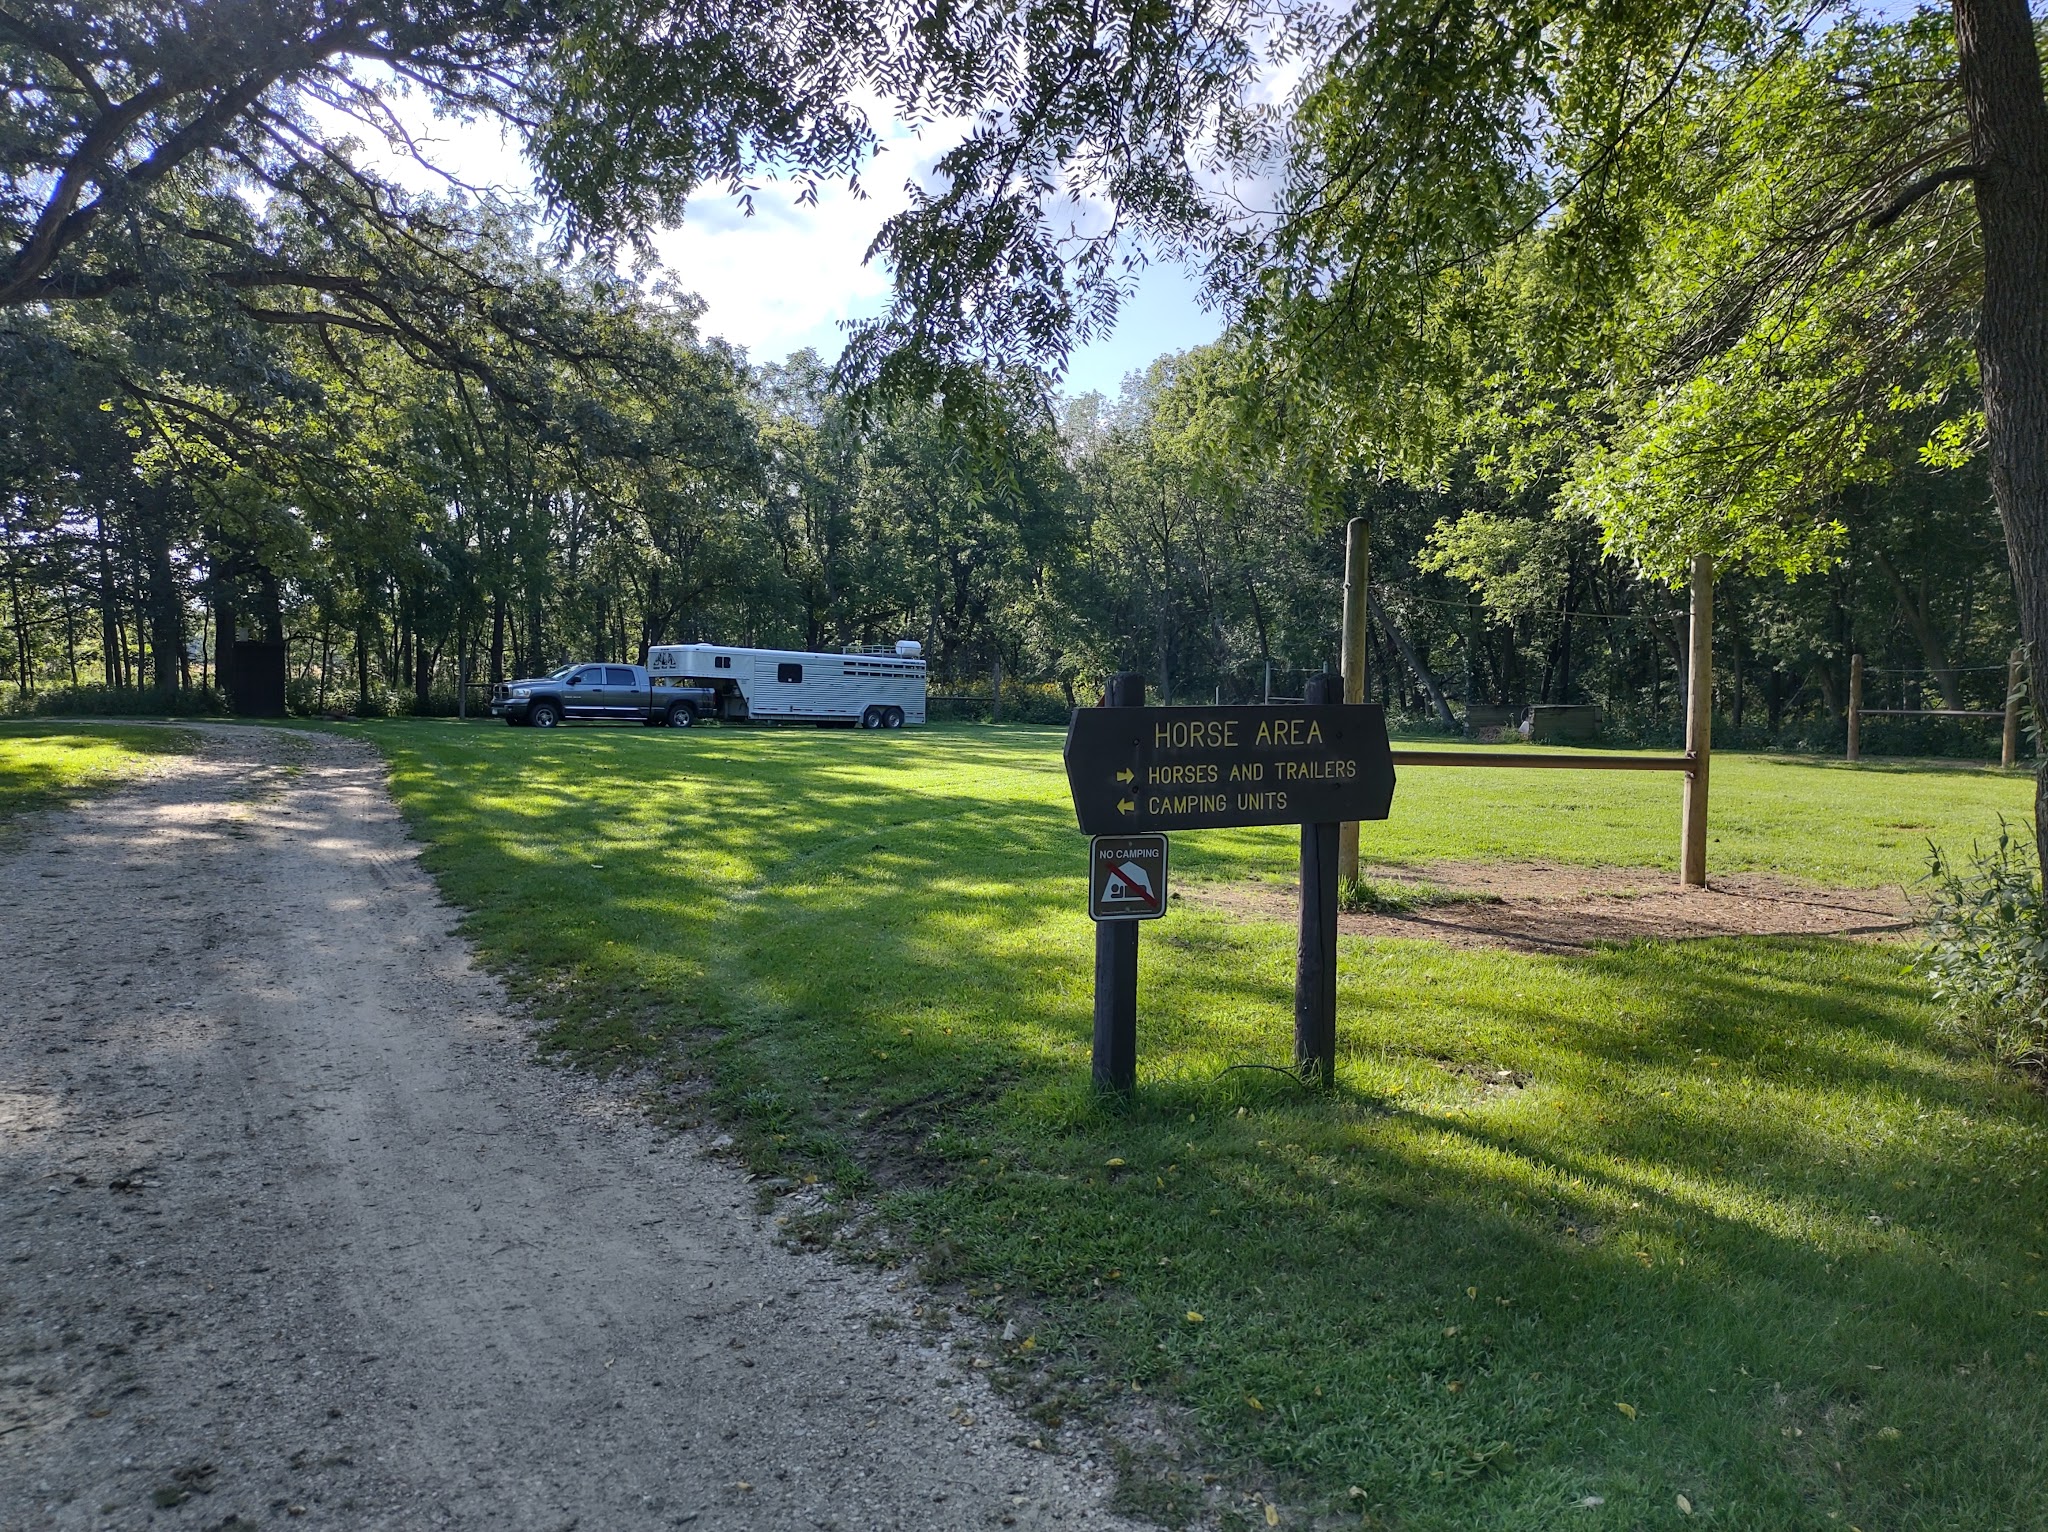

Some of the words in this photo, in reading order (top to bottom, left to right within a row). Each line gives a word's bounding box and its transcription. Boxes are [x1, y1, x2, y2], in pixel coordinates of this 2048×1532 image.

[1155, 720, 1239, 748] HORSE
[1255, 719, 1323, 746] AREA
[1148, 764, 1218, 784] HORSES
[1229, 762, 1264, 782] AND
[1274, 760, 1357, 780] TRAILERS
[1148, 793, 1227, 815] CAMPING
[1237, 791, 1288, 811] UNITS
[1099, 850, 1114, 859] NO
[1116, 848, 1160, 859] CAMPING
